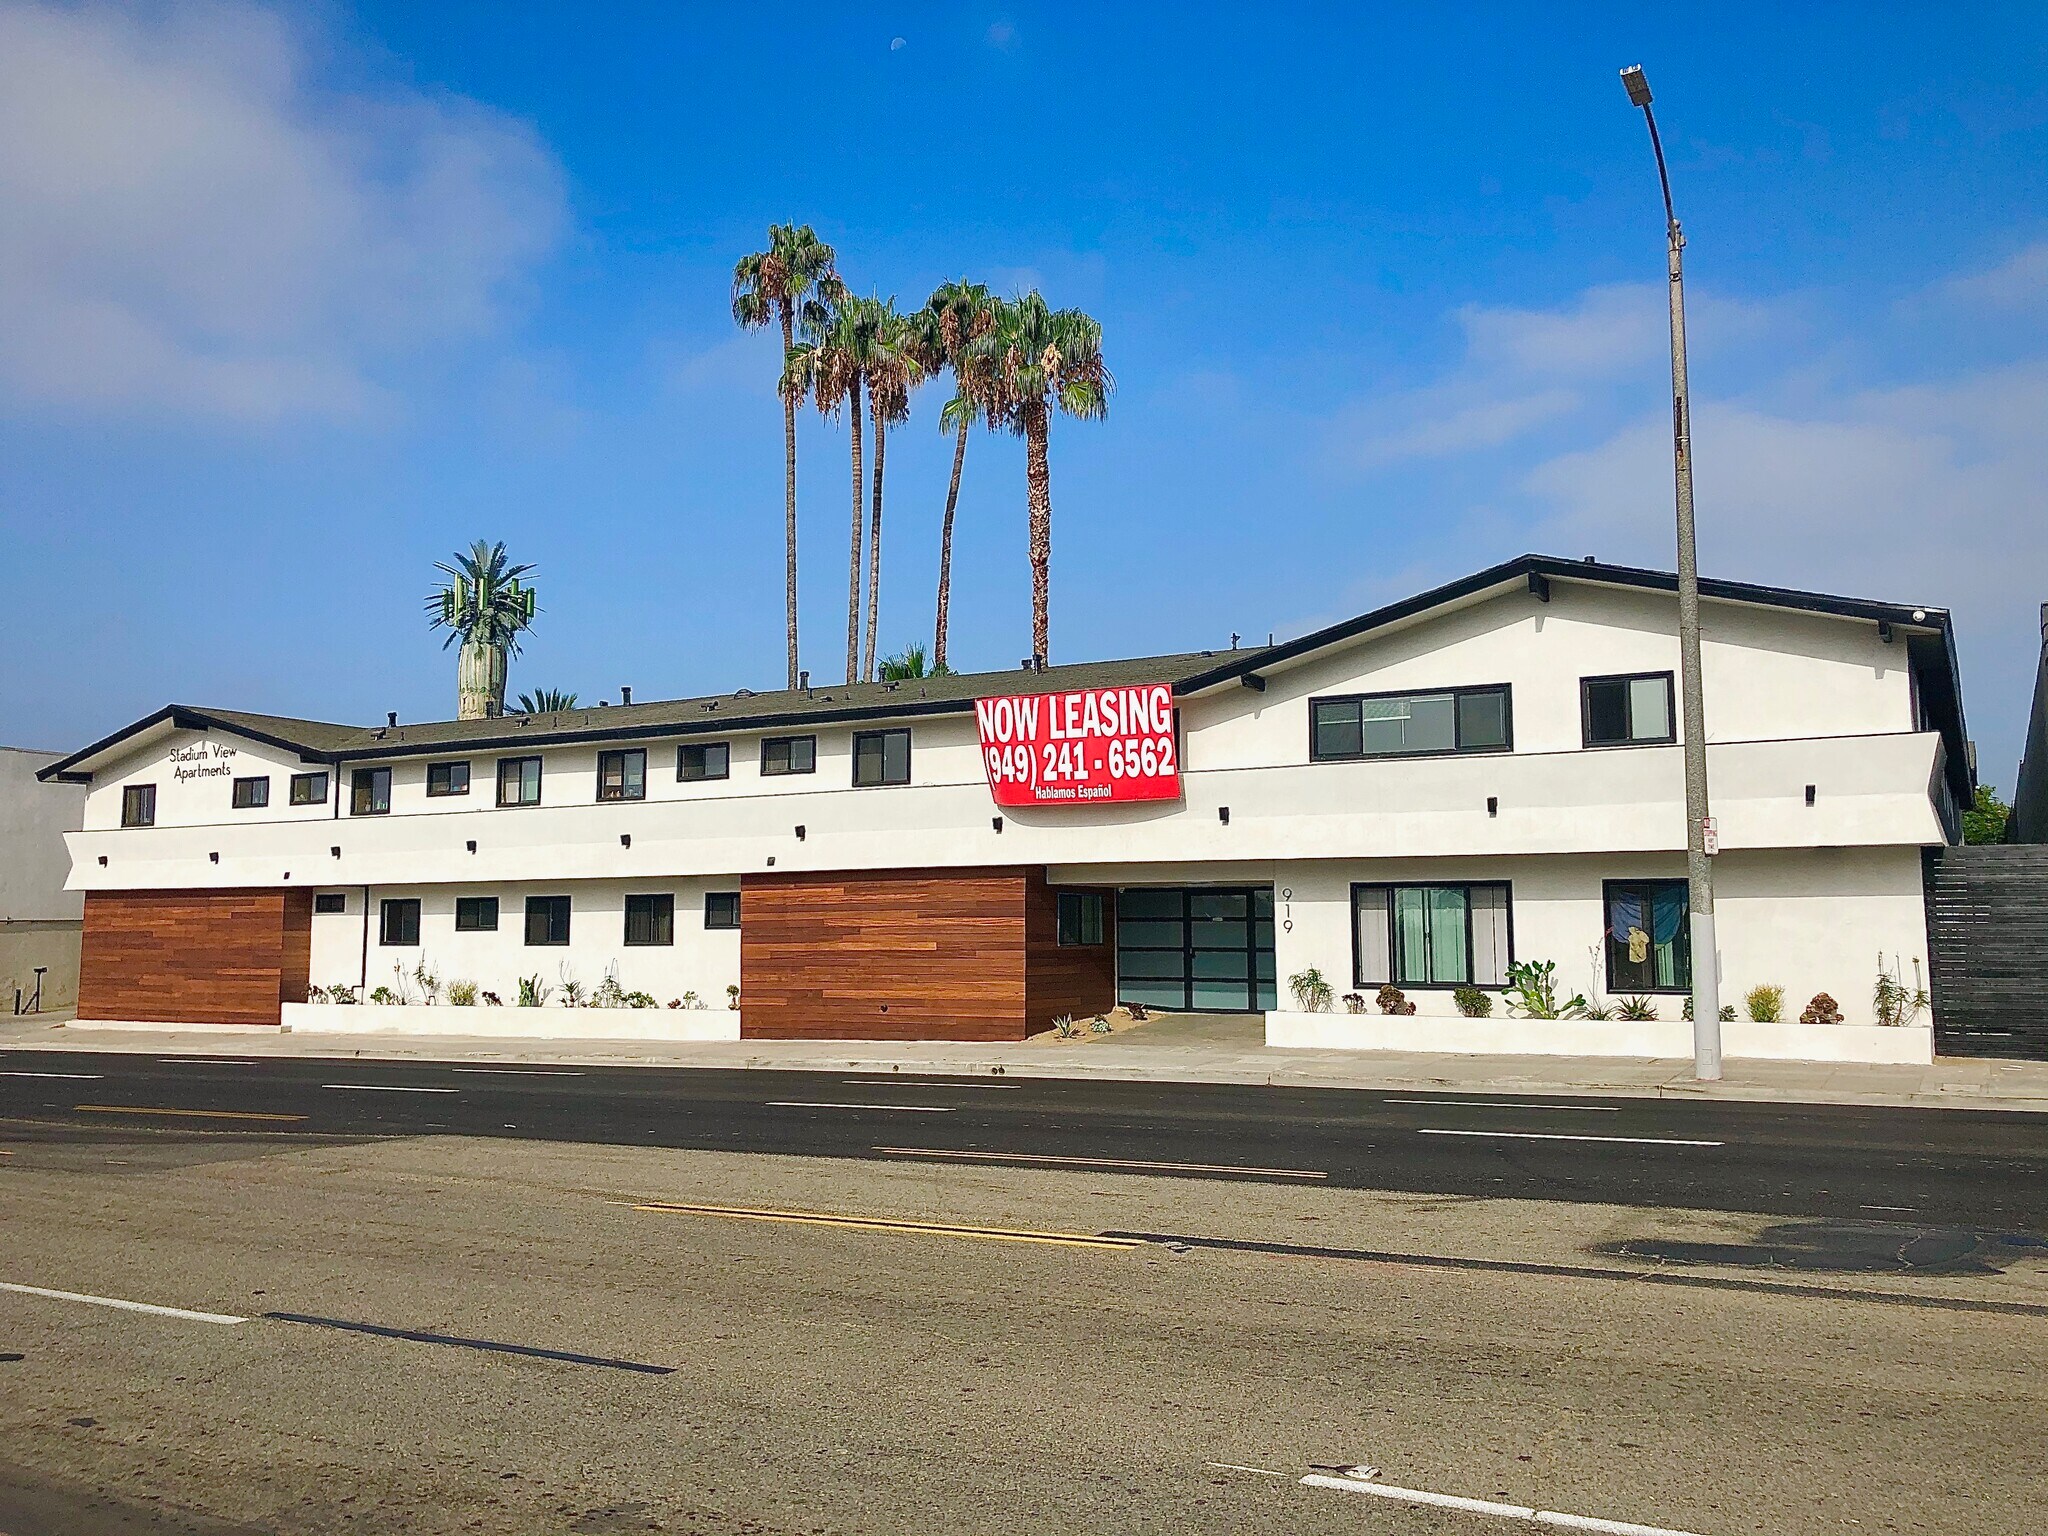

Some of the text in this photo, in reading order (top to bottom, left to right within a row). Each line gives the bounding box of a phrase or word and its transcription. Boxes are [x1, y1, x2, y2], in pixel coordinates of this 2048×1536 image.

[976, 687, 1172, 744] NOW LEASING
[169, 744, 238, 762] Stadium View
[984, 744, 1038, 790] (949)
[173, 761, 231, 784] Apartments
[1035, 783, 1112, 800] Hablamos Español
[1282, 888, 1293, 934] 919
